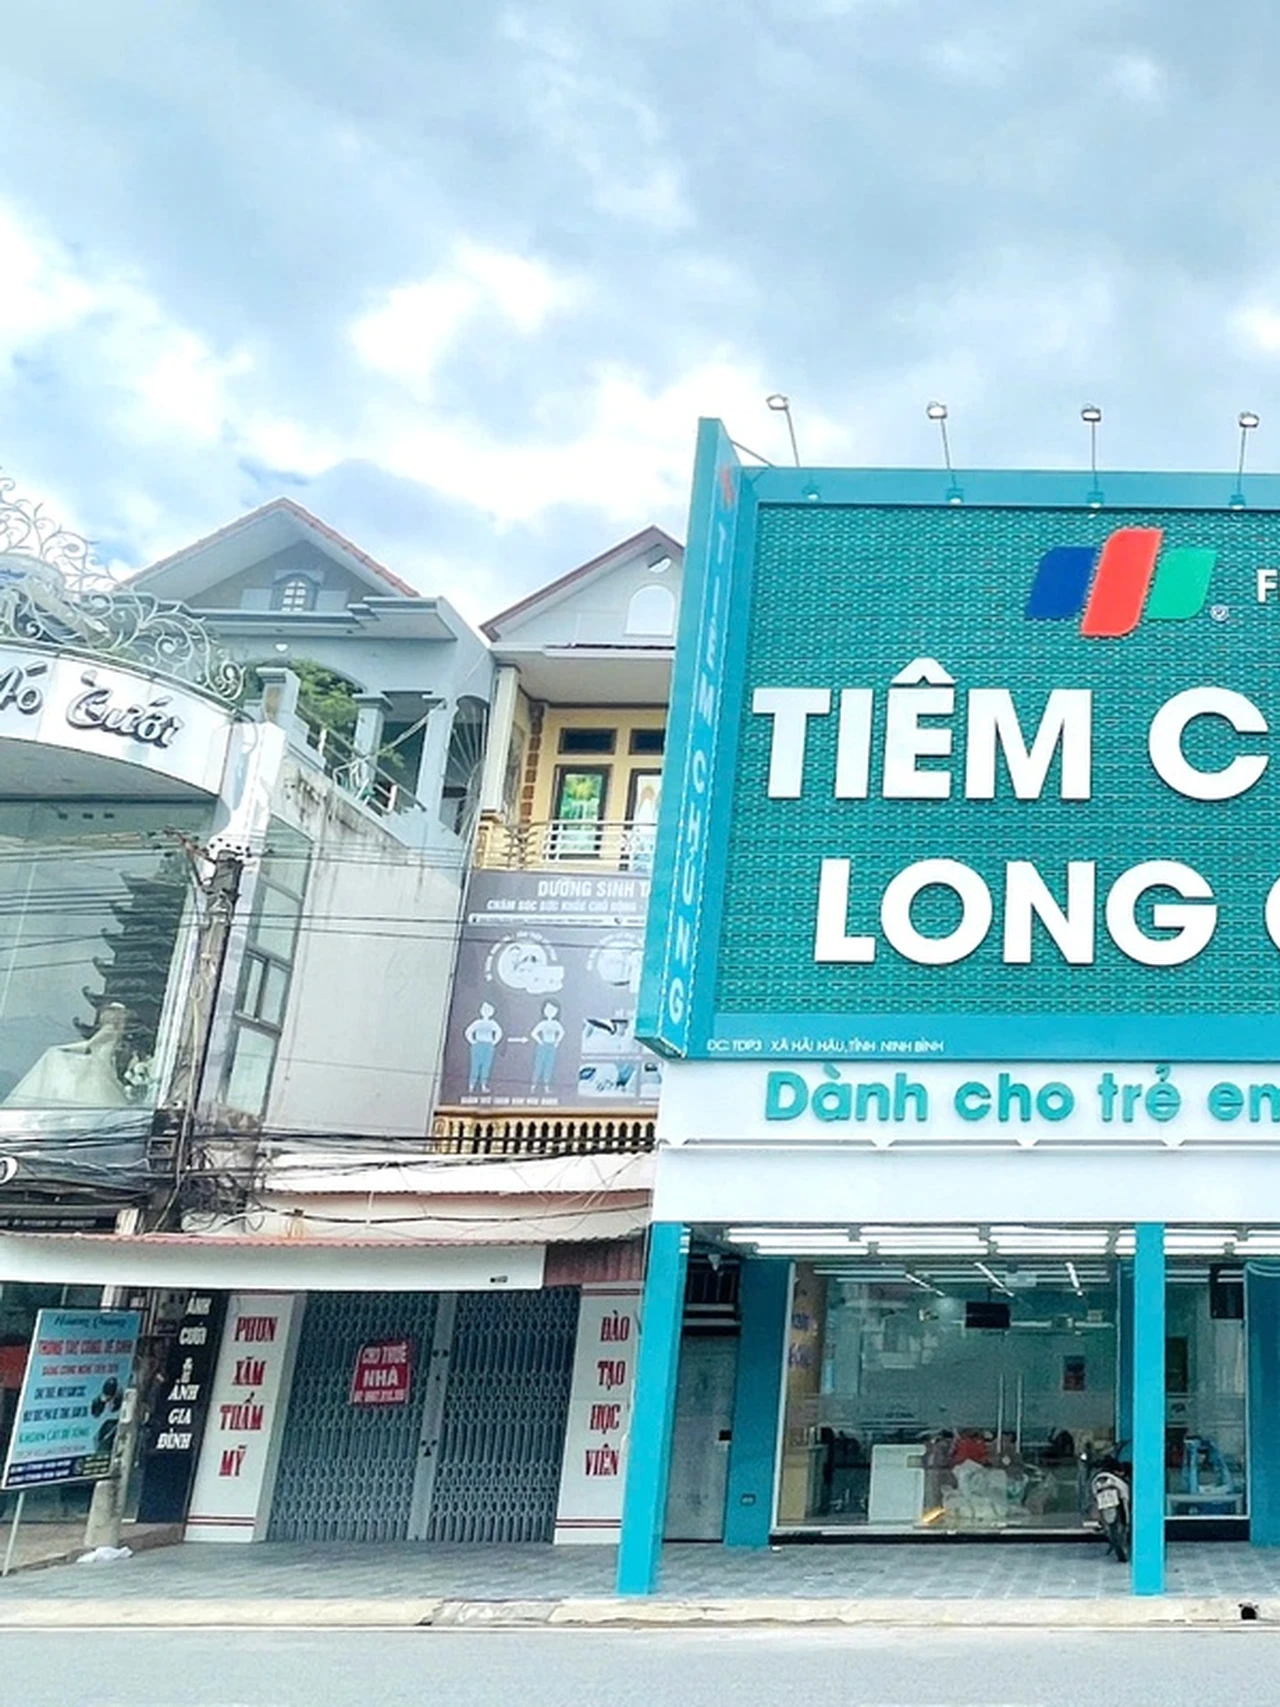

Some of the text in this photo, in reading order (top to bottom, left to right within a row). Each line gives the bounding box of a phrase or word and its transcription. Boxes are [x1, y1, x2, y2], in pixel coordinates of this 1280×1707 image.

[752, 658, 1092, 801] TIÊM
[537, 877, 591, 898] DƯỠNG
[597, 881, 635, 898] SINH
[814, 856, 1219, 967] LONG
[880, 1038, 912, 1051] NINH
[765, 1064, 929, 1122] Dành
[954, 1073, 1075, 1122] cho
[1097, 1065, 1181, 1123] trẻ
[234, 1316, 278, 1342] PHUN
[601, 1310, 630, 1341] ĐÀO
[362, 1365, 399, 1388] NHÀ
[597, 1361, 626, 1390] TẠO
[168, 1408, 192, 1425] GIA
[589, 1404, 621, 1434] HỌC
[219, 1444, 248, 1477] MỸ
[585, 1443, 620, 1476] VIÊN
